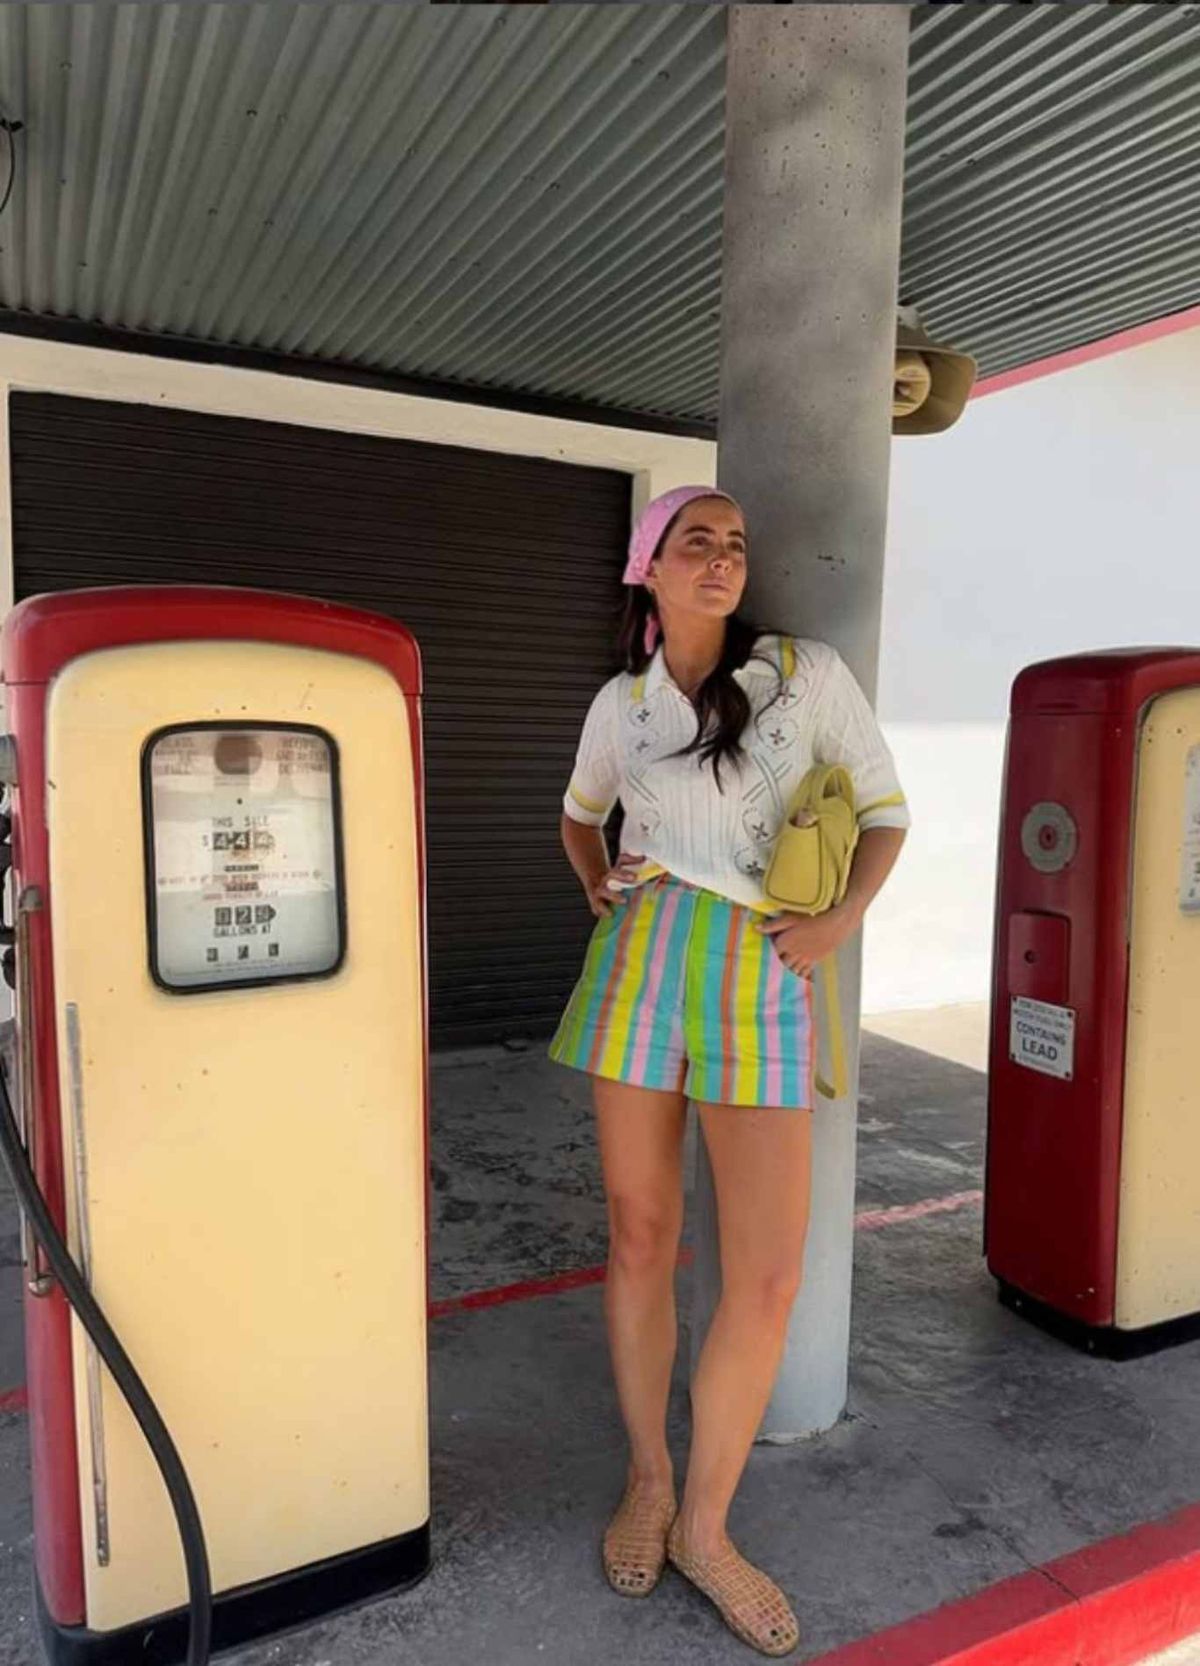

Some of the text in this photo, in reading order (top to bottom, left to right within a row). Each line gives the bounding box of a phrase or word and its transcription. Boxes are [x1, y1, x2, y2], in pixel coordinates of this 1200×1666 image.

[212, 816, 233, 828] THIS
[213, 925, 258, 938] GALLONS
[1022, 1038, 1058, 1061] LEAD
